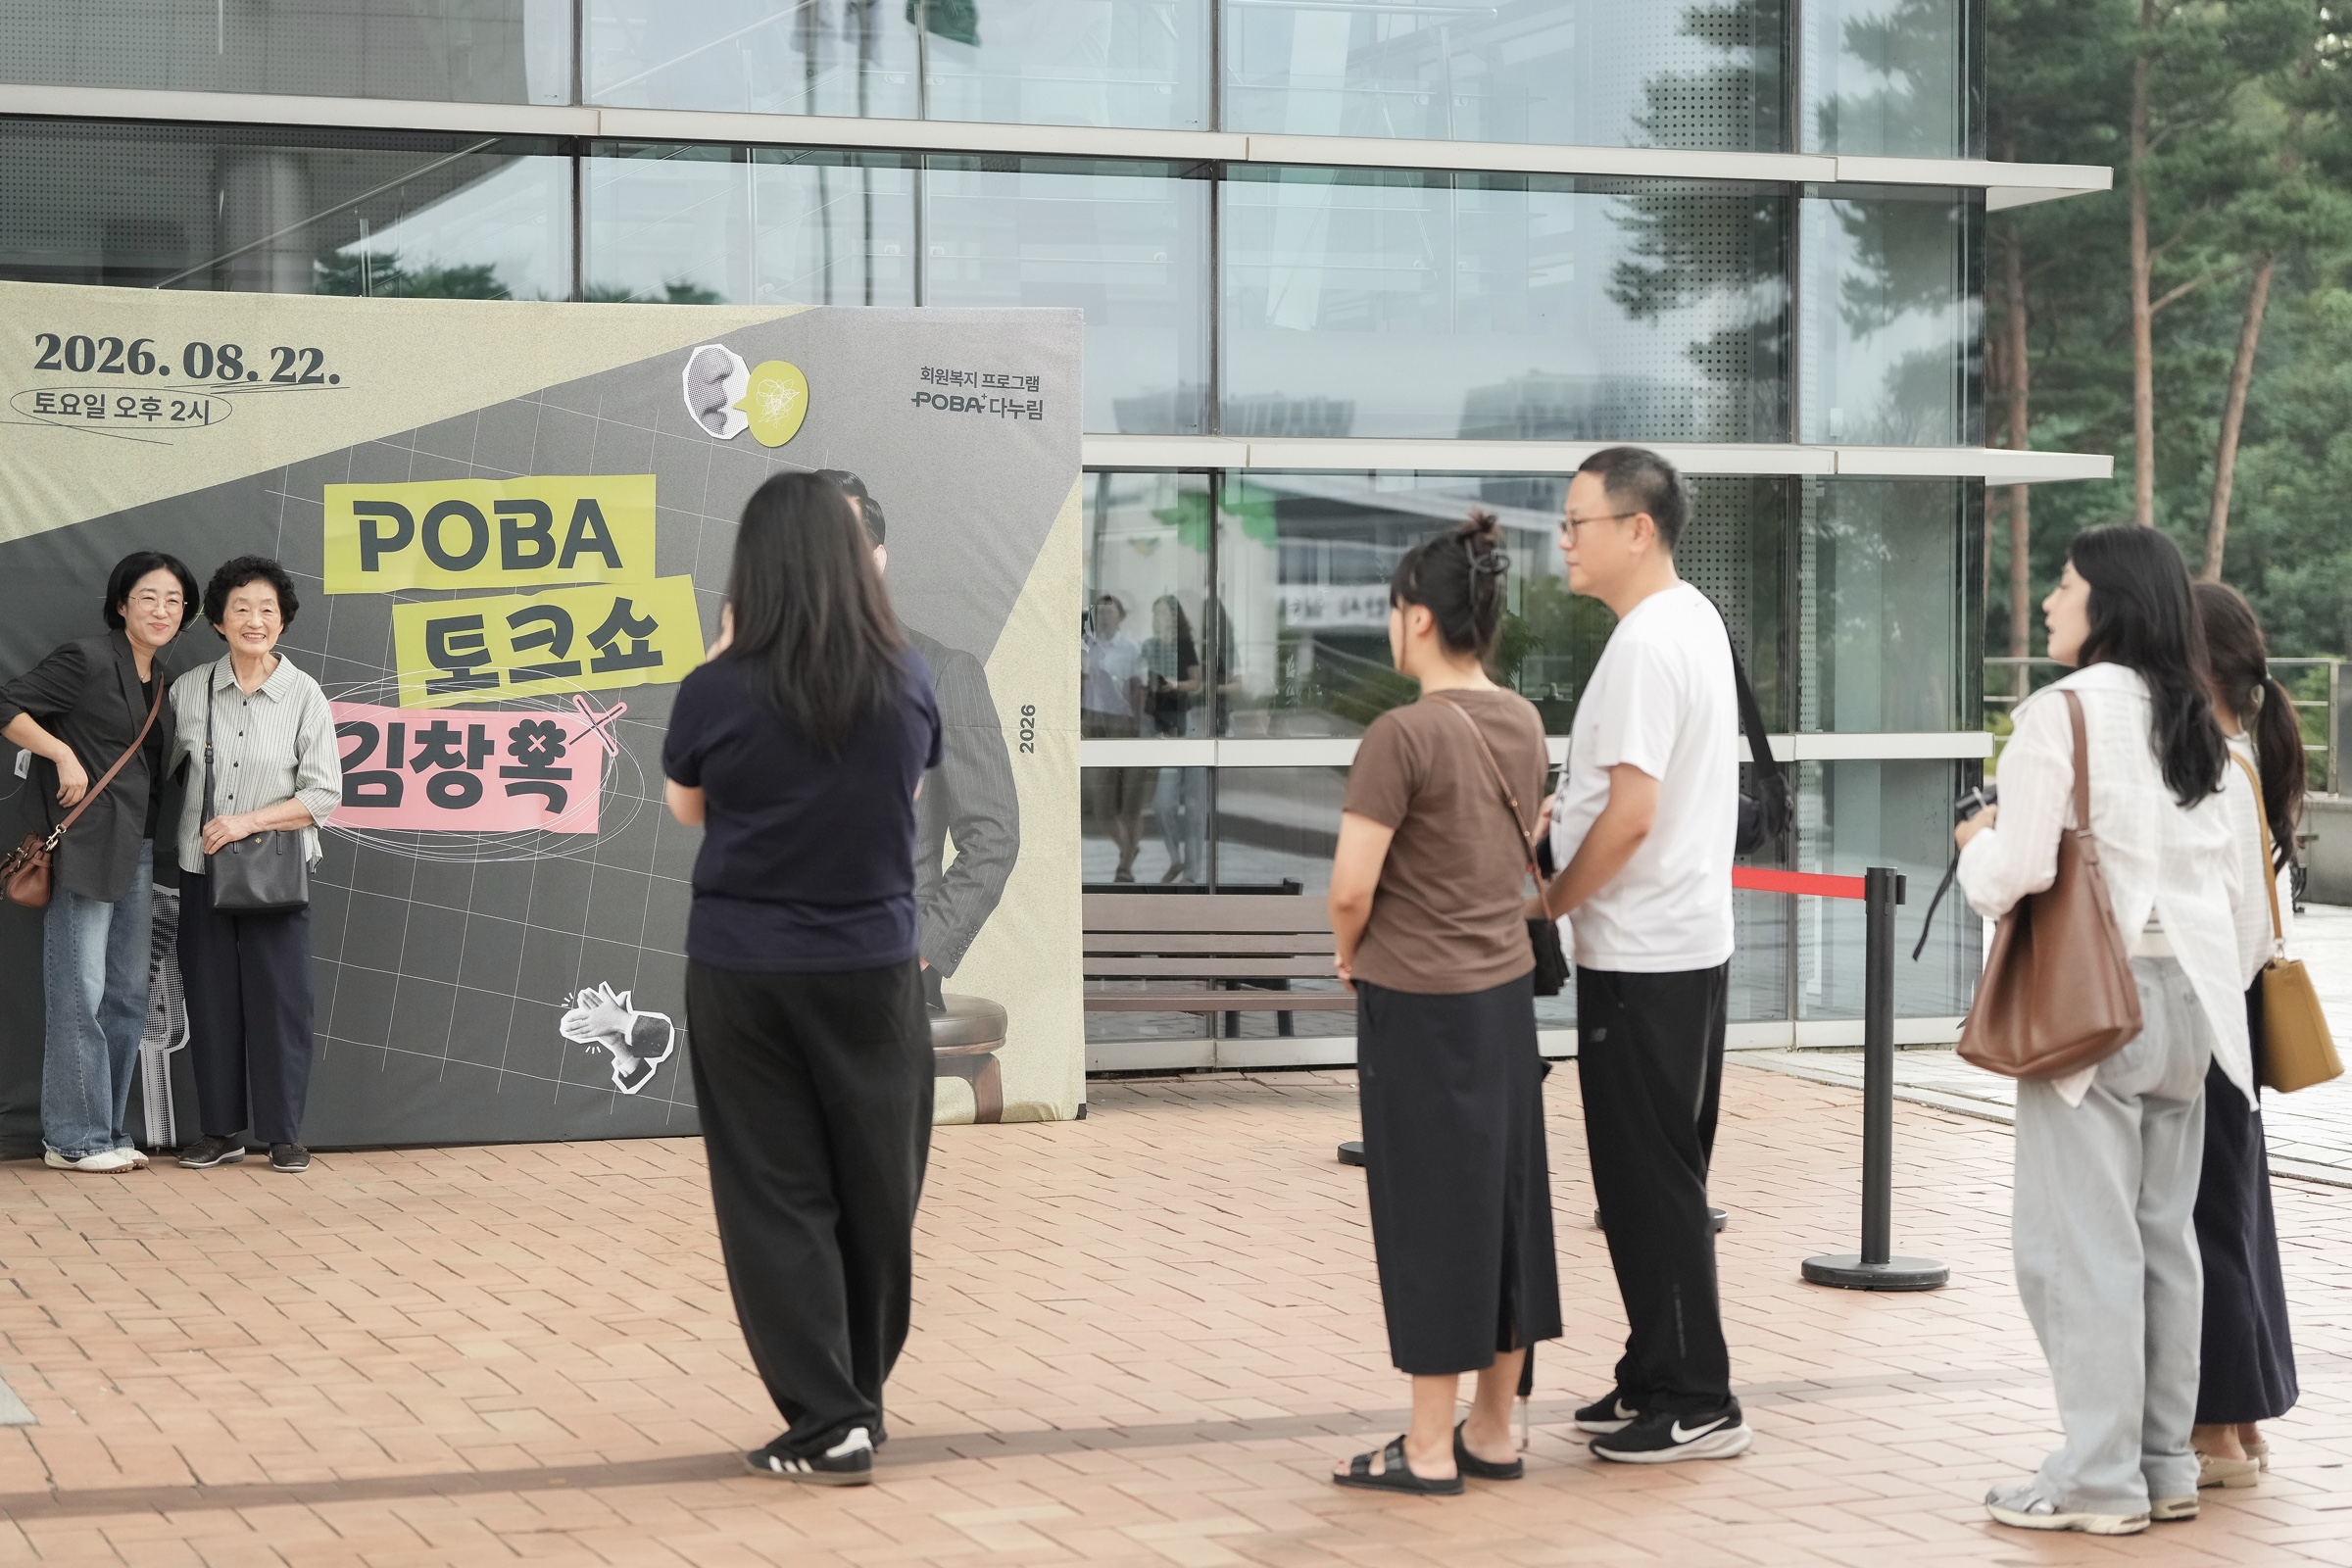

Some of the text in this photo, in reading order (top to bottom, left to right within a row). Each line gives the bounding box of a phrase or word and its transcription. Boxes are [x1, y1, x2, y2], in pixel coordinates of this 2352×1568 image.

[33, 332, 341, 385] 2026. 08. 22.
[919, 366, 1040, 393] 회원복지 프로그램
[32, 392, 210, 425] 토요일 오후 2시
[989, 397, 1044, 420] 다누림
[352, 498, 624, 572] POBA
[424, 596, 664, 697] 토크쇼
[1018, 704, 1036, 755] 2026
[334, 718, 573, 814] 김창옥
